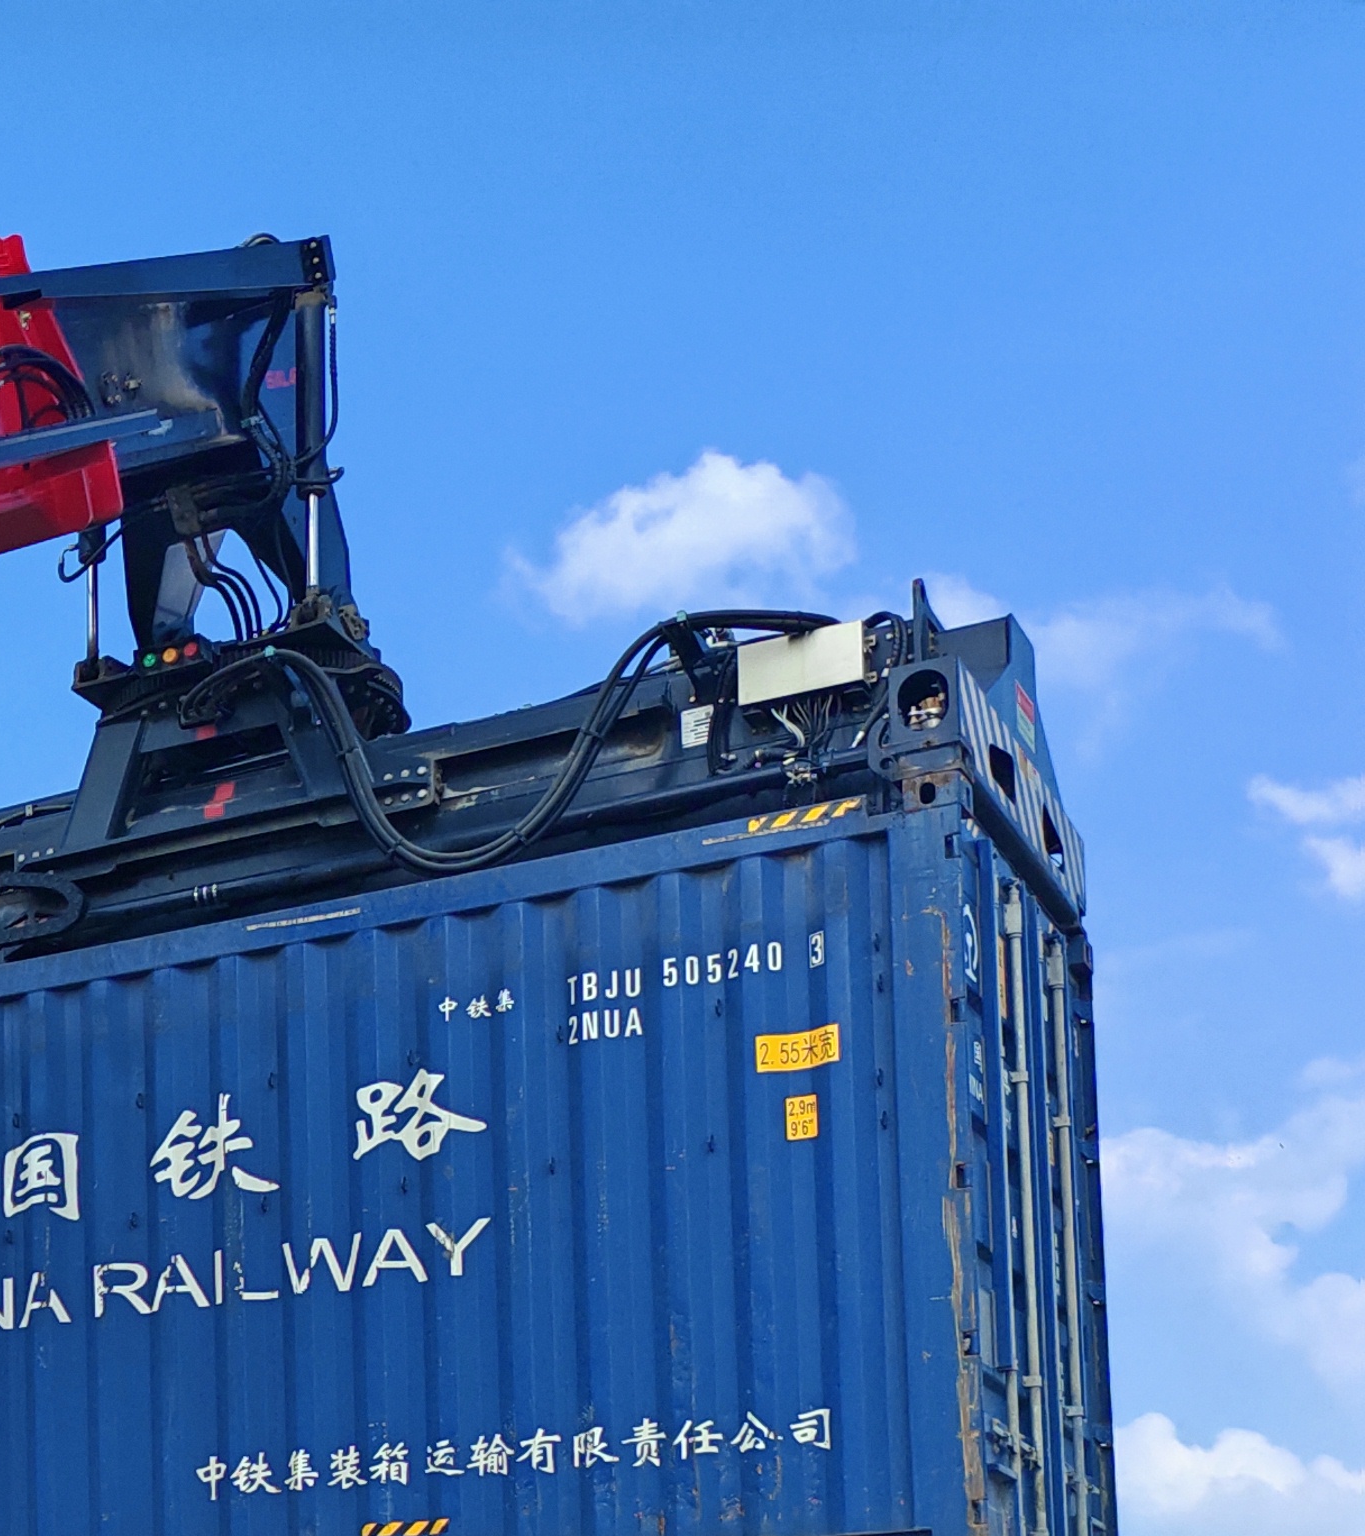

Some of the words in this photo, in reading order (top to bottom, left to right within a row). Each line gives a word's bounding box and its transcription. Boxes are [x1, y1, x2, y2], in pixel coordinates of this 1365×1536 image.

[567, 967, 642, 1005] TBJU
[663, 941, 783, 987] 505240
[810, 933, 824, 967] 3
[438, 988, 515, 1022] 中铁集
[568, 1007, 643, 1044] 2NUA
[760, 1029, 837, 1066] 2.55米宽
[93, 1217, 491, 1319] RAILWAY
[196, 1408, 833, 1501] 中铁集装箱运输有限责任公司
